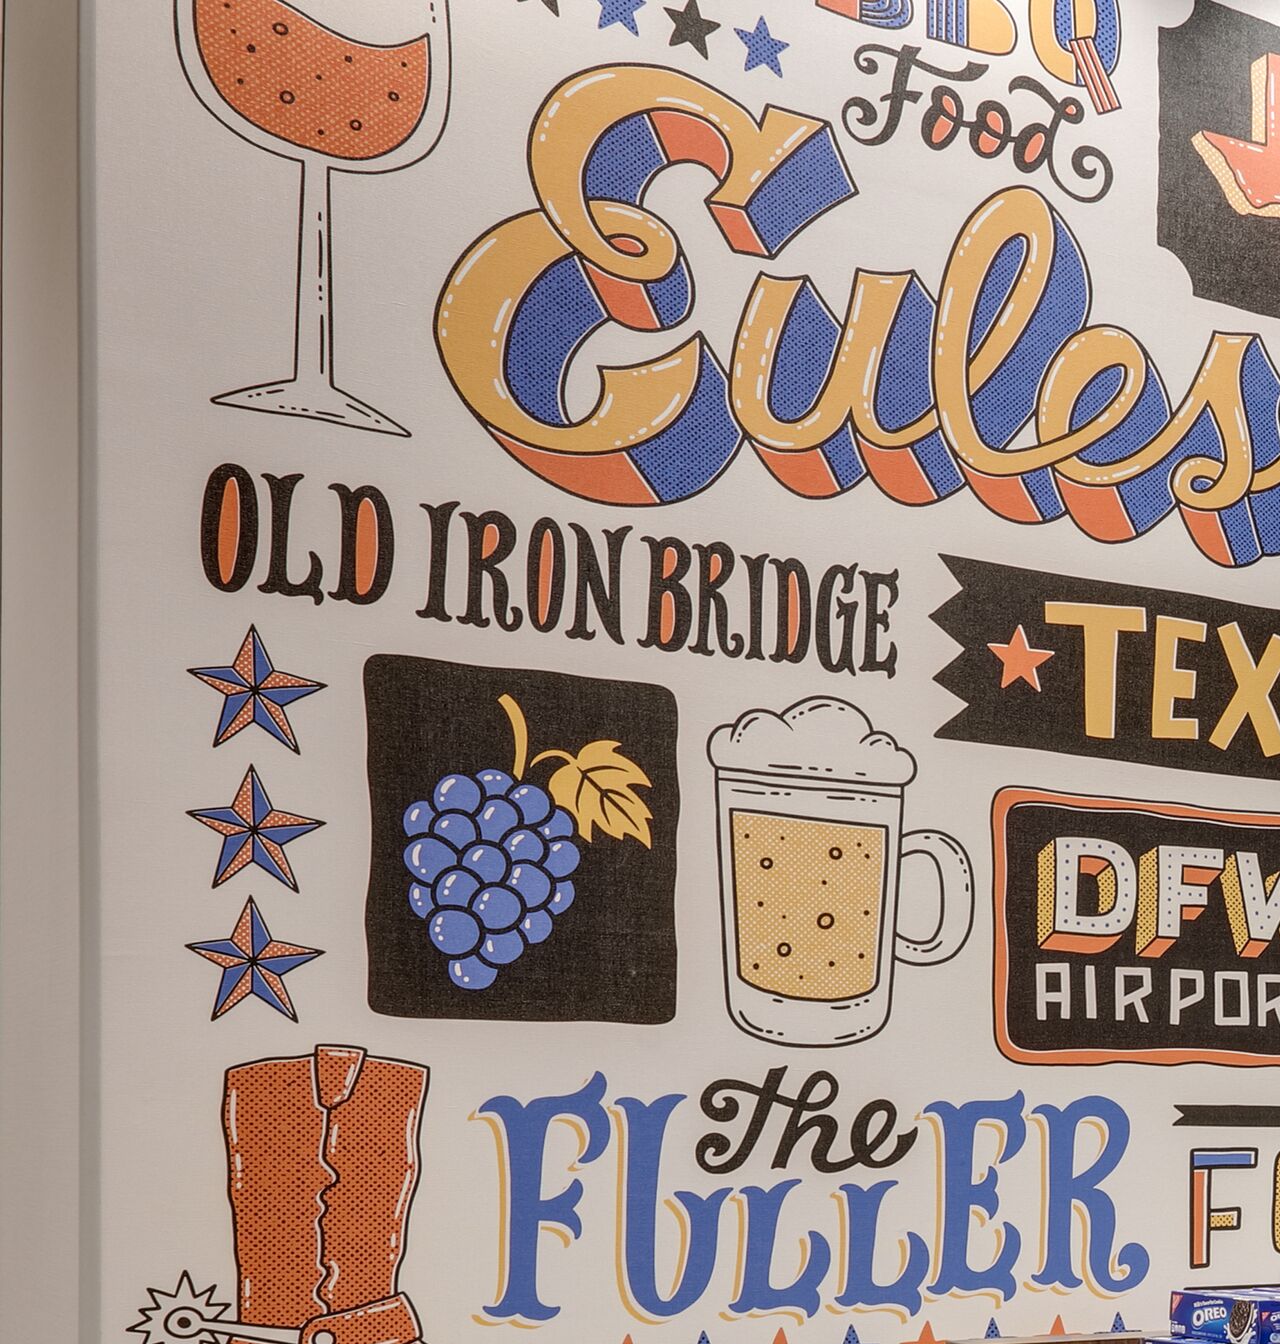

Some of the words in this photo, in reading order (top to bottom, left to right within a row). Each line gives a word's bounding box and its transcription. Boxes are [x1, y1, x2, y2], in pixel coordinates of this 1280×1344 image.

[842, 44, 1113, 202] Food
[200, 463, 394, 605] OLD
[416, 501, 635, 645] IRON
[637, 535, 900, 679] BRIDGE
[695, 1065, 920, 1174] The
[467, 1070, 1149, 1328] FULLER
[1192, 1306, 1227, 1327] OREO
